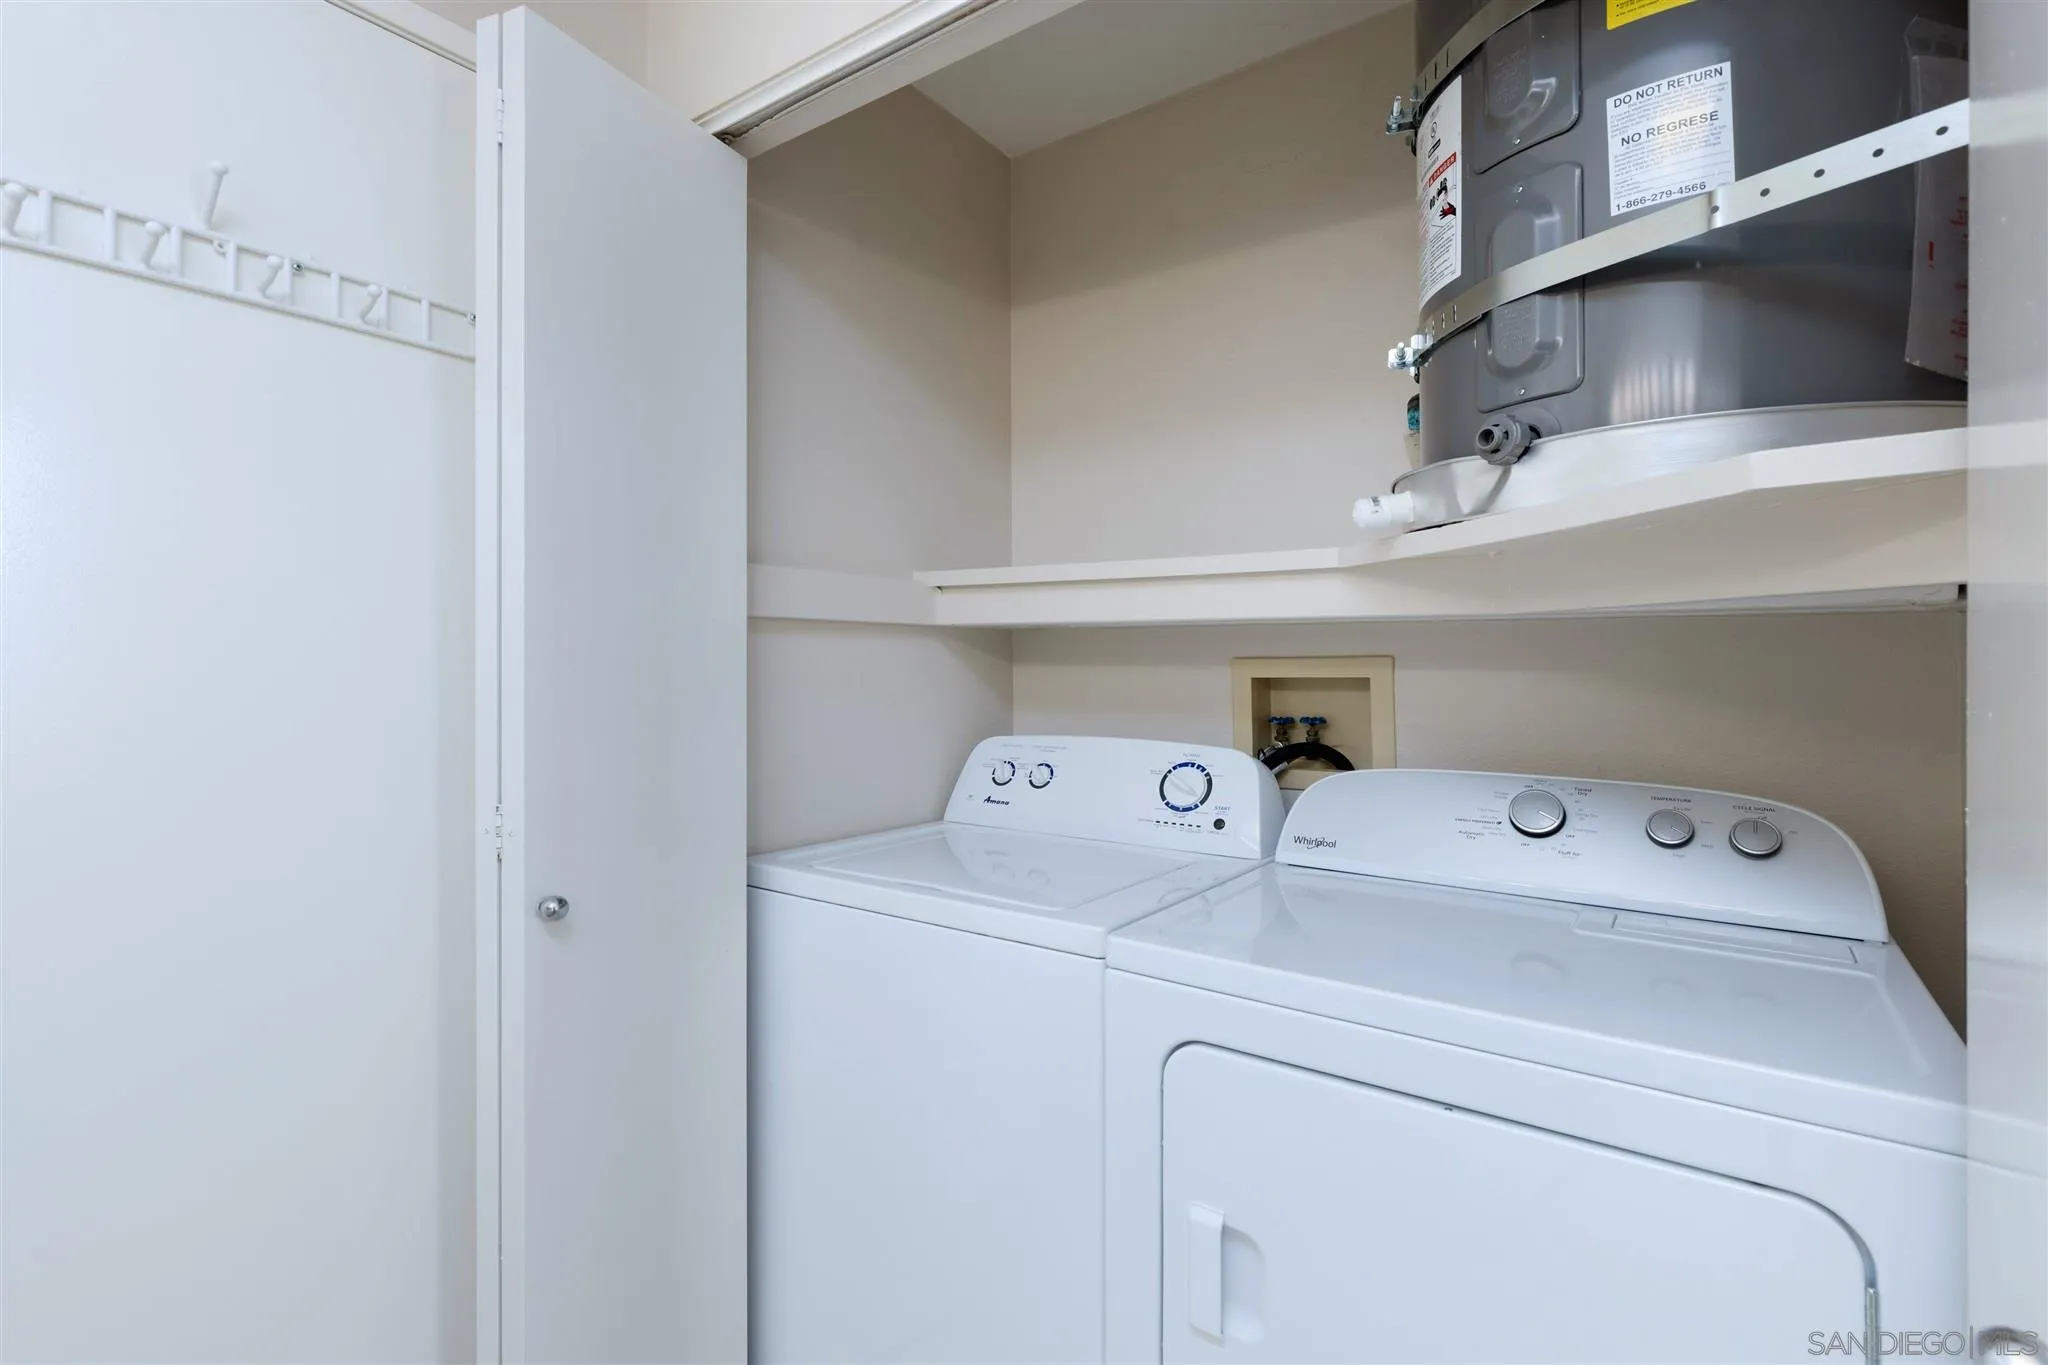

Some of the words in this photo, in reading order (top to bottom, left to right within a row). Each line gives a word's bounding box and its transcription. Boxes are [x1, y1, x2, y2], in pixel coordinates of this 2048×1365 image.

[1614, 95, 1632, 108] DO
[1636, 83, 1662, 100] NOT
[1667, 66, 1723, 90] RETURN
[1621, 132, 1641, 146] NO
[1646, 110, 1719, 138] REGRESE
[1615, 181, 1707, 211] 1-866-279-4566
[984, 795, 1010, 806] Amana
[1293, 836, 1337, 849] Whirlpool
